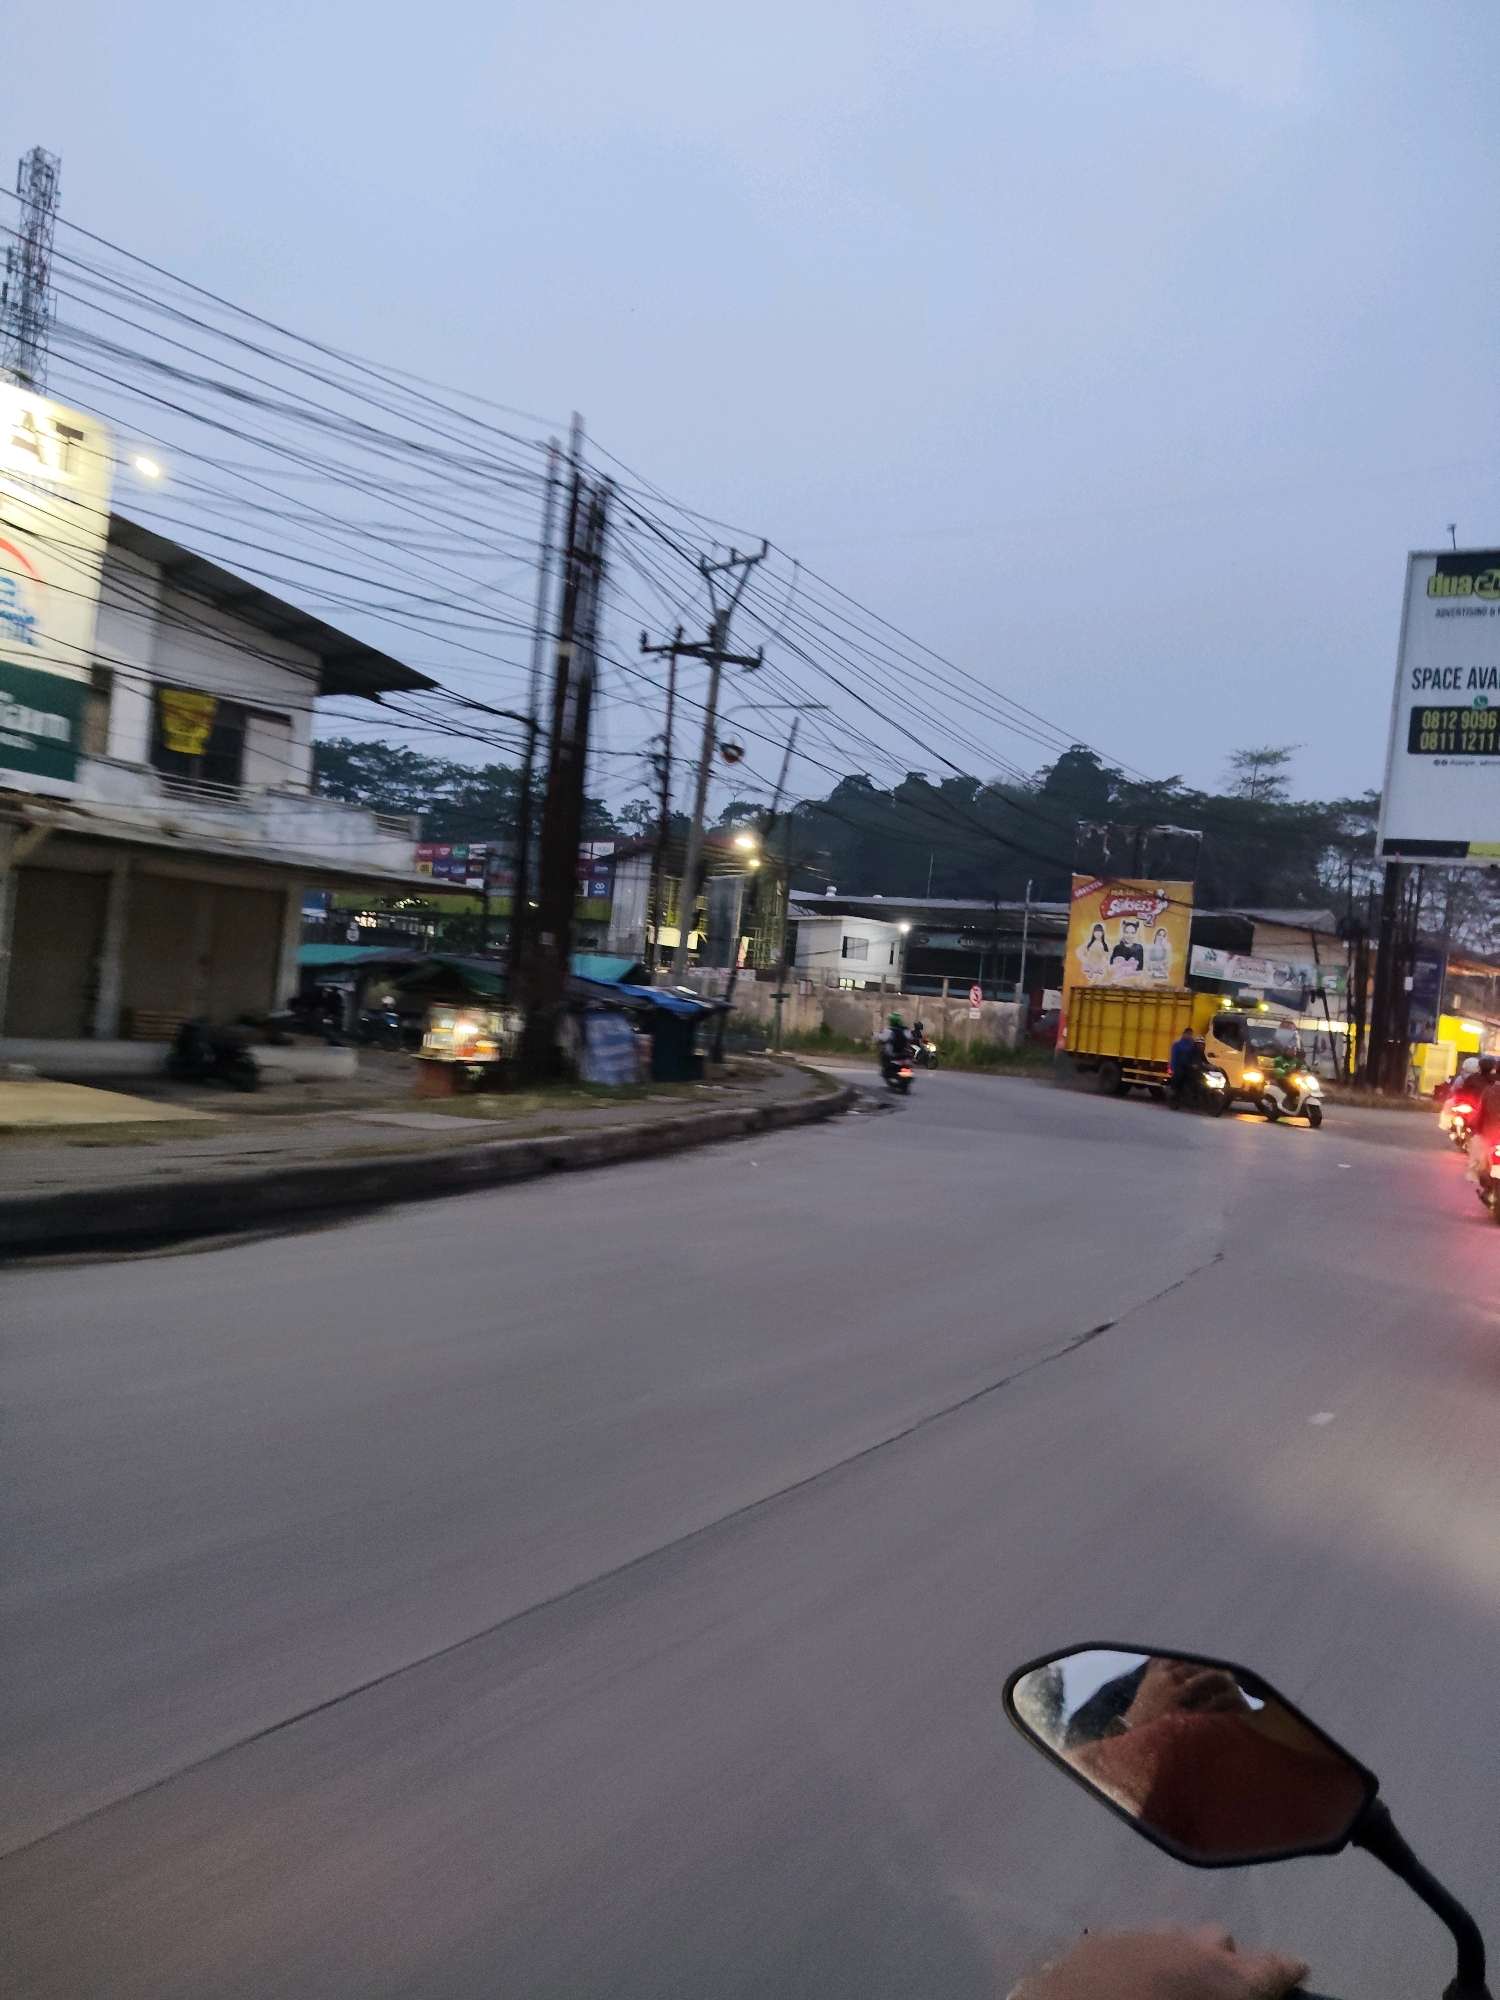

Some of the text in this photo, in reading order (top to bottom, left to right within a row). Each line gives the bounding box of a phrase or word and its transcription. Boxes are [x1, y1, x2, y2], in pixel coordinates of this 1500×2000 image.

[1411, 666, 1500, 690] SPACE AVA
[1422, 709, 1497, 731] 0812 9096
[1420, 731, 1494, 752] 0811 1211
